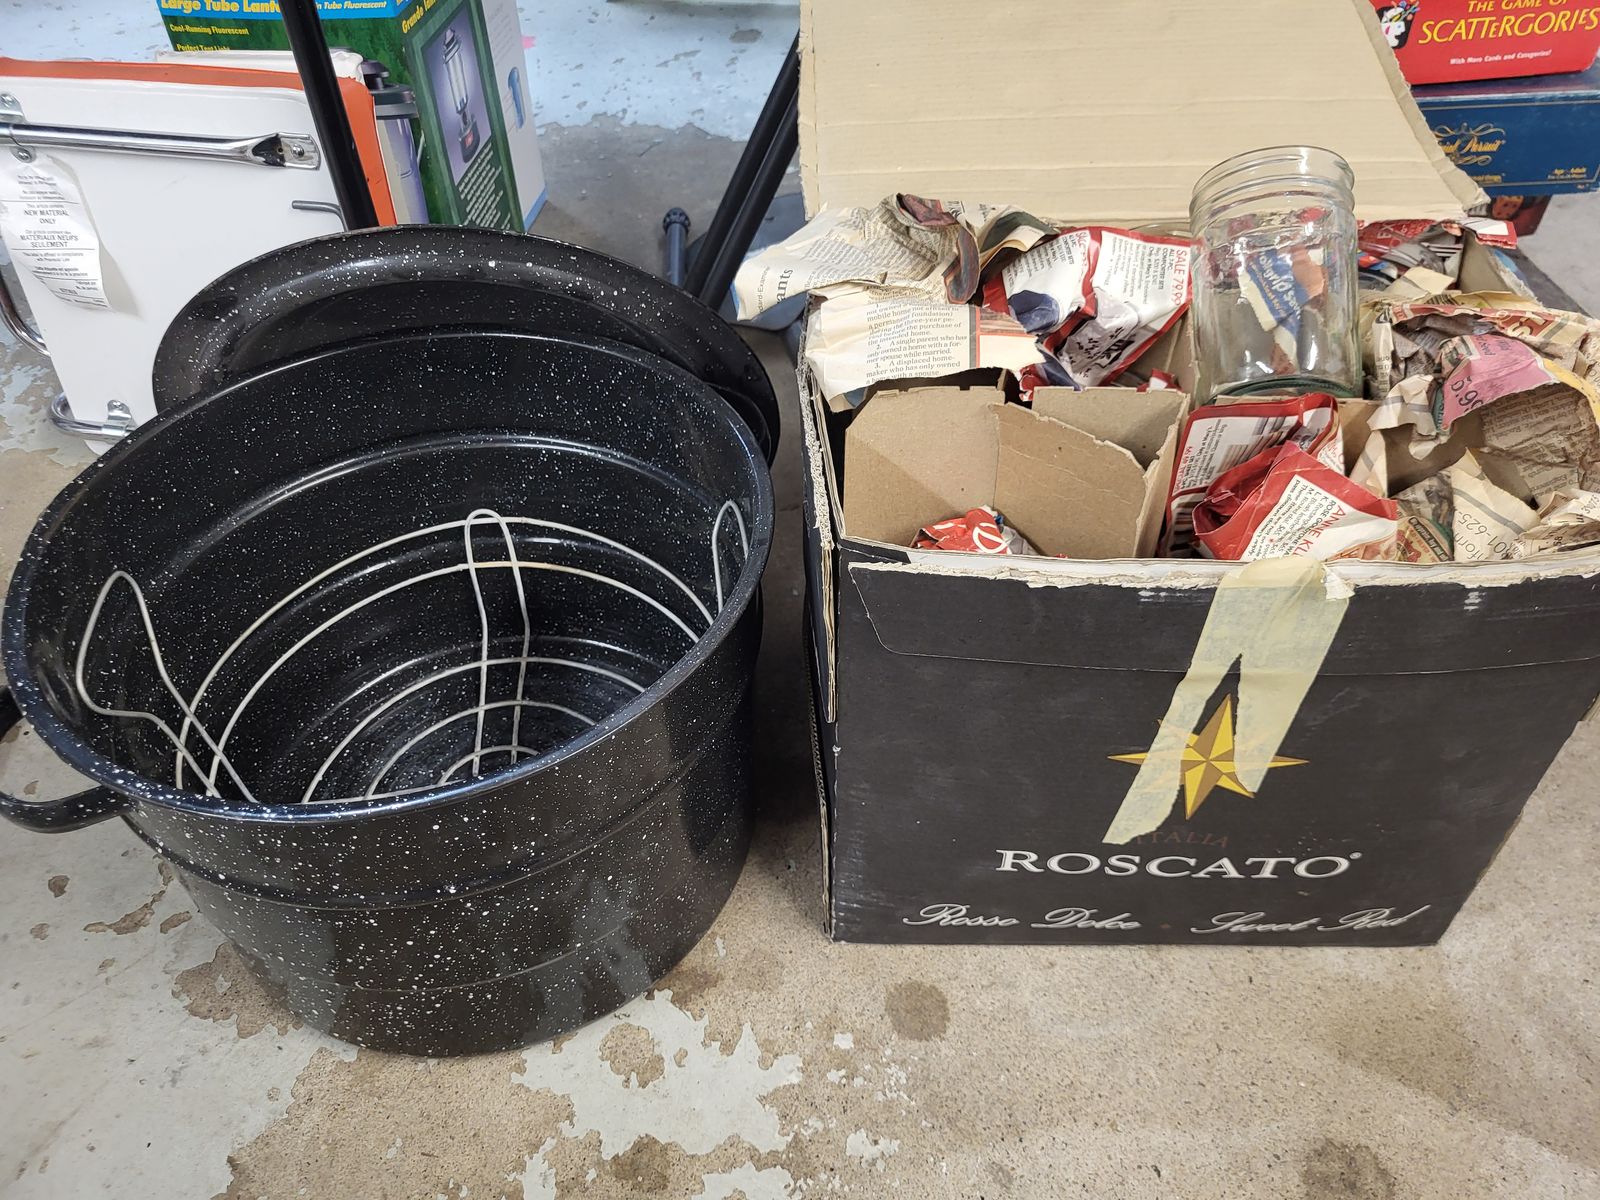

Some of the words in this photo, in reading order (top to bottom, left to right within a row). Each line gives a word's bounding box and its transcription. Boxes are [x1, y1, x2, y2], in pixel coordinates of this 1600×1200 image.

[1468, 1, 1494, 12] THE
[1501, 0, 1542, 10] GAME
[1418, 7, 1600, 45] SCATTERGORIES
[1174, 249, 1187, 274] SALE
[776, 268, 794, 304] ants
[896, 338, 915, 347] single
[916, 336, 939, 344] parent
[928, 341, 942, 349] with
[896, 356, 931, 366] displaced
[903, 350, 922, 358] while
[866, 369, 888, 378] maker
[889, 364, 904, 373] who
[1310, 506, 1345, 538] ANNE
[996, 849, 1352, 879] ROSCATO
[902, 902, 1021, 929] Rosso
[1030, 907, 1142, 931] Dolce
[1189, 911, 1320, 934] Sweet
[1317, 905, 1431, 931] Red
